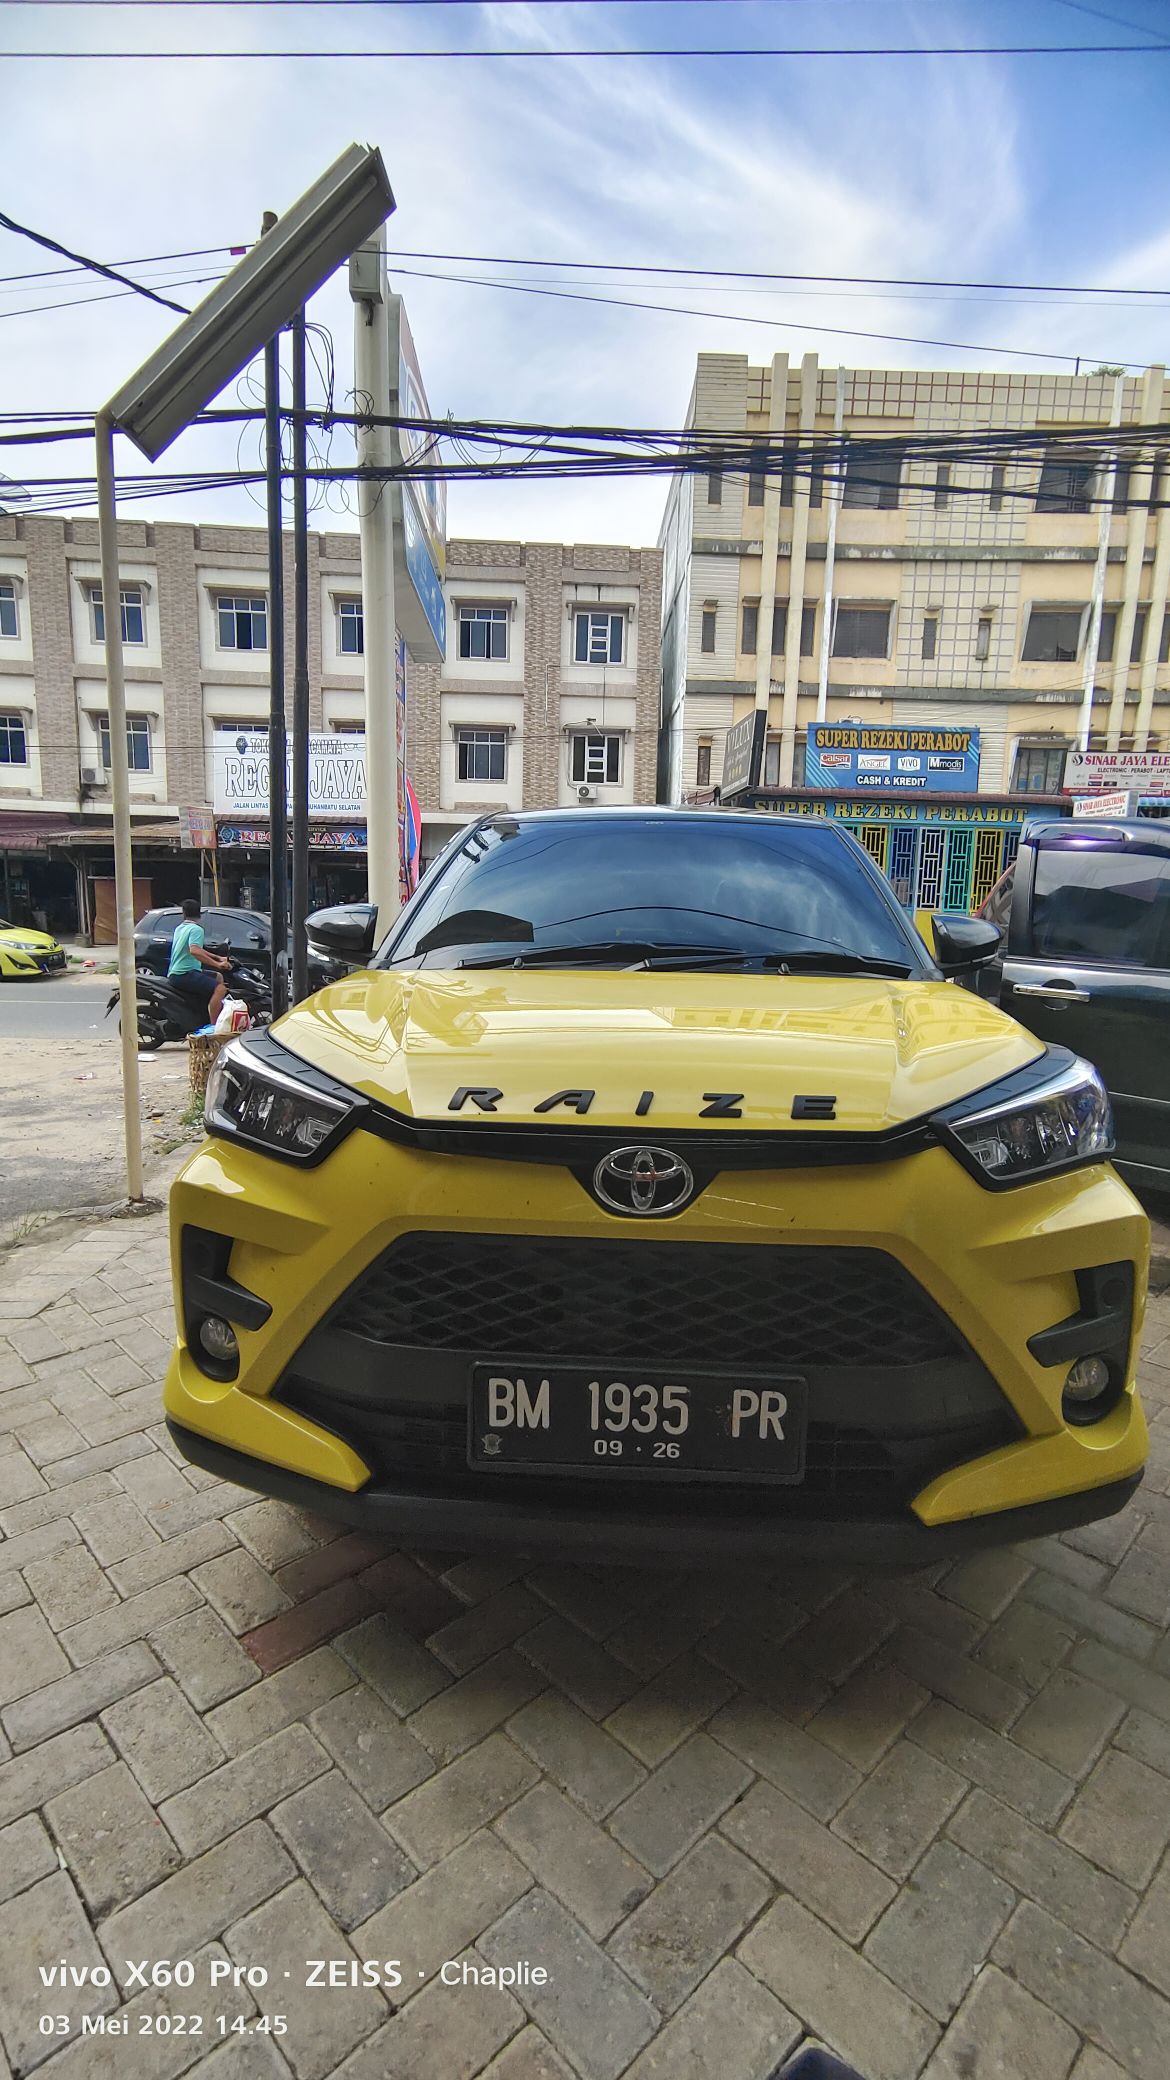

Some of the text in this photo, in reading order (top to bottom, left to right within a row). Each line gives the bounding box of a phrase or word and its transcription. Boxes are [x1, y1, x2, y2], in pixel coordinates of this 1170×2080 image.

[816, 730, 971, 752] SUPER REZEKI PERABOT
[1085, 755, 1117, 766] SINAR
[1120, 755, 1147, 766] JAYA
[310, 760, 367, 799] JAYA
[857, 776, 927, 787] CASH & KREDIT
[755, 801, 1028, 822] SUPER REZEKI PERABOT
[309, 832, 359, 845] JAYA
[447, 1086, 837, 1120] RAIZE
[488, 1377, 788, 1441] BM 1935 PR
[593, 1439, 681, 1459] 09 26
